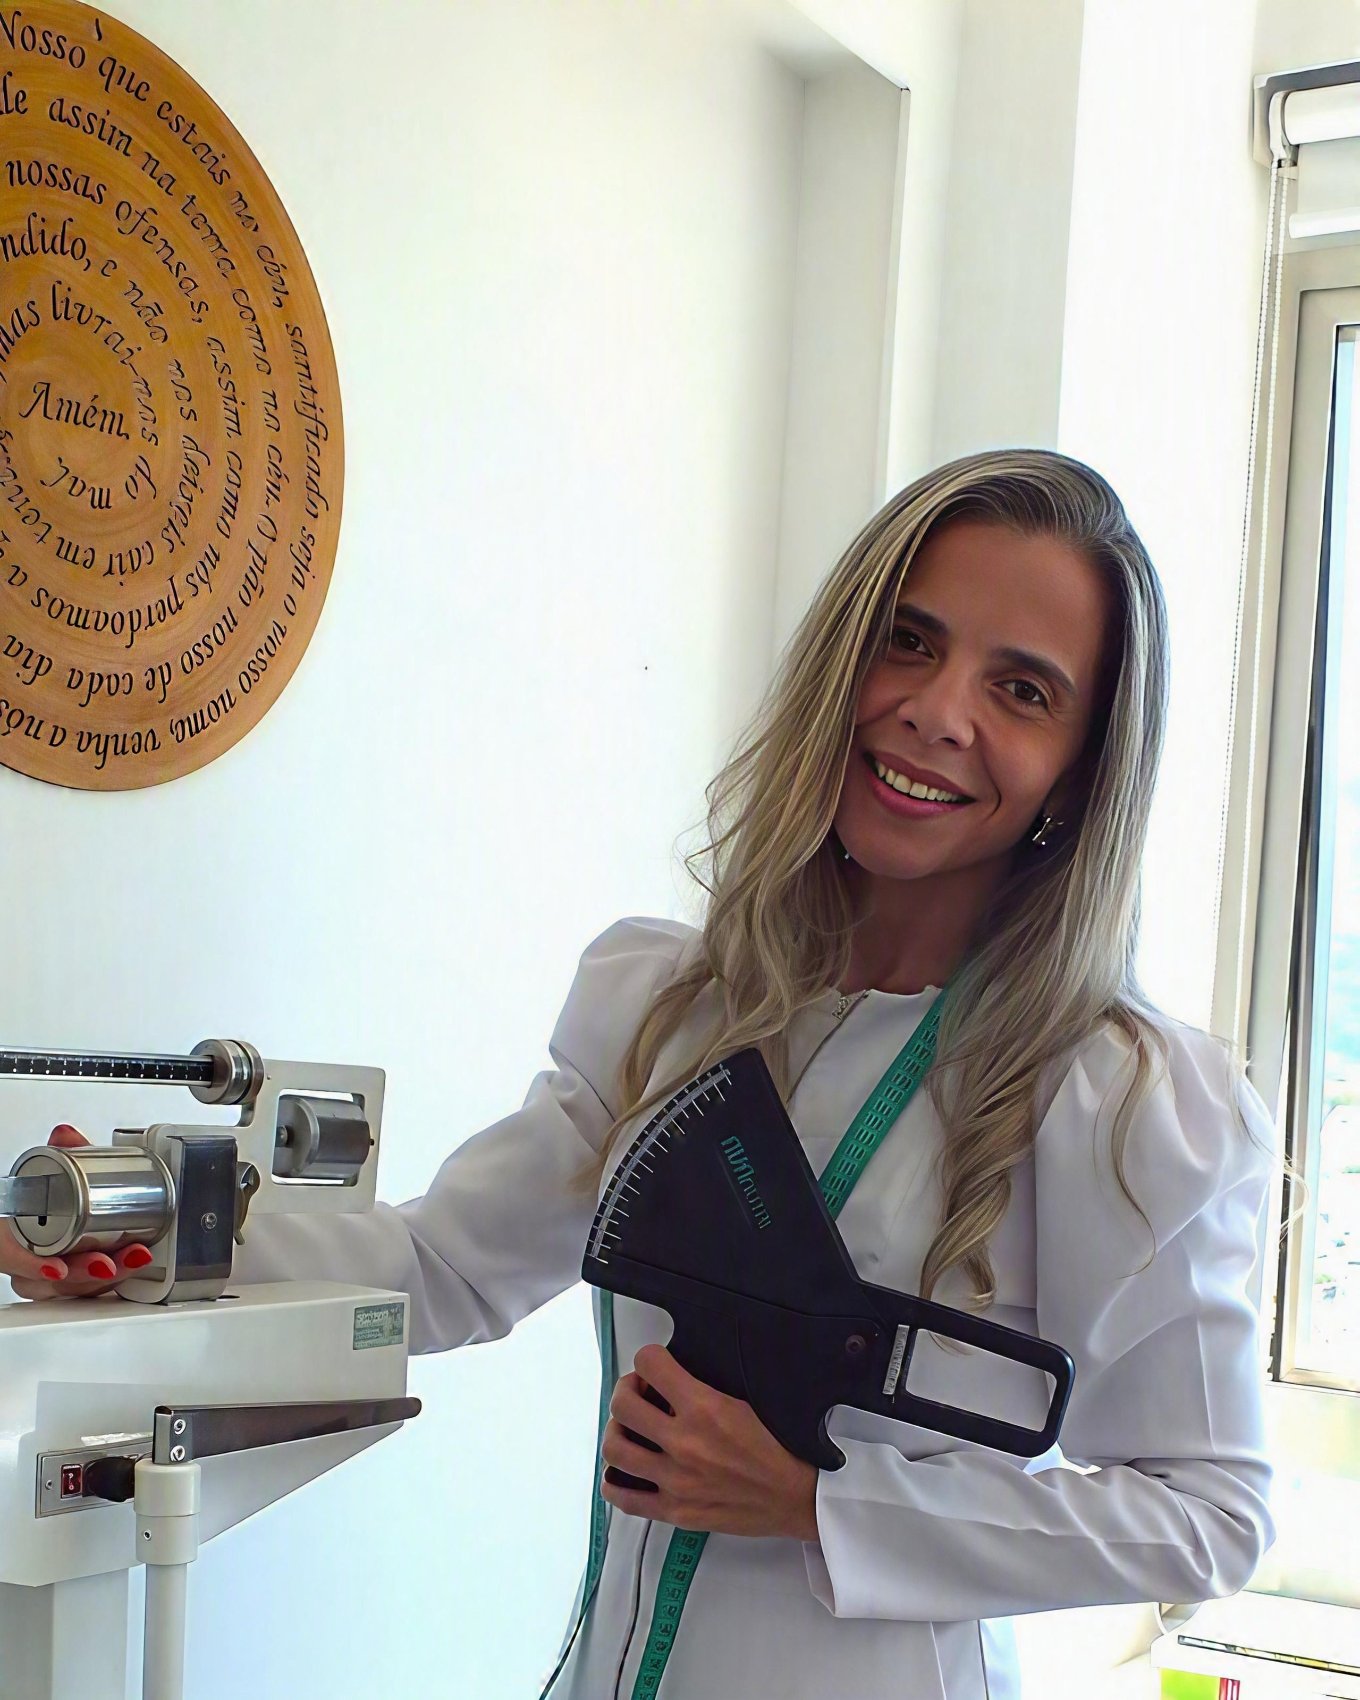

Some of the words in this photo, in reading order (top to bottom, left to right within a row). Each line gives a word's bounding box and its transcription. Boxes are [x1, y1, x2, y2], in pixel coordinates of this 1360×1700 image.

[98, 56, 150, 101] que
[49, 98, 131, 157] assim
[156, 101, 231, 186] estais
[6, 160, 107, 205] nossas
[142, 152, 178, 197] na
[101, 259, 118, 277] e
[232, 288, 272, 376] como
[285, 323, 329, 519] santificado
[125, 455, 157, 499] do
[216, 450, 243, 539] como
[257, 513, 278, 543] O
[7, 564, 28, 587] a
[56, 536, 96, 570] em
[102, 541, 154, 587] cair
[186, 543, 221, 597] nós
[290, 525, 316, 589] seja
[30, 575, 185, 648] perdoamos
[282, 595, 297, 617] o
[3, 635, 53, 685] dia
[180, 606, 240, 675] nosso
[238, 620, 287, 695] vosso
[66, 667, 133, 708] cada
[145, 667, 173, 704] de
[49, 725, 67, 747] a
[77, 729, 161, 770] venha
